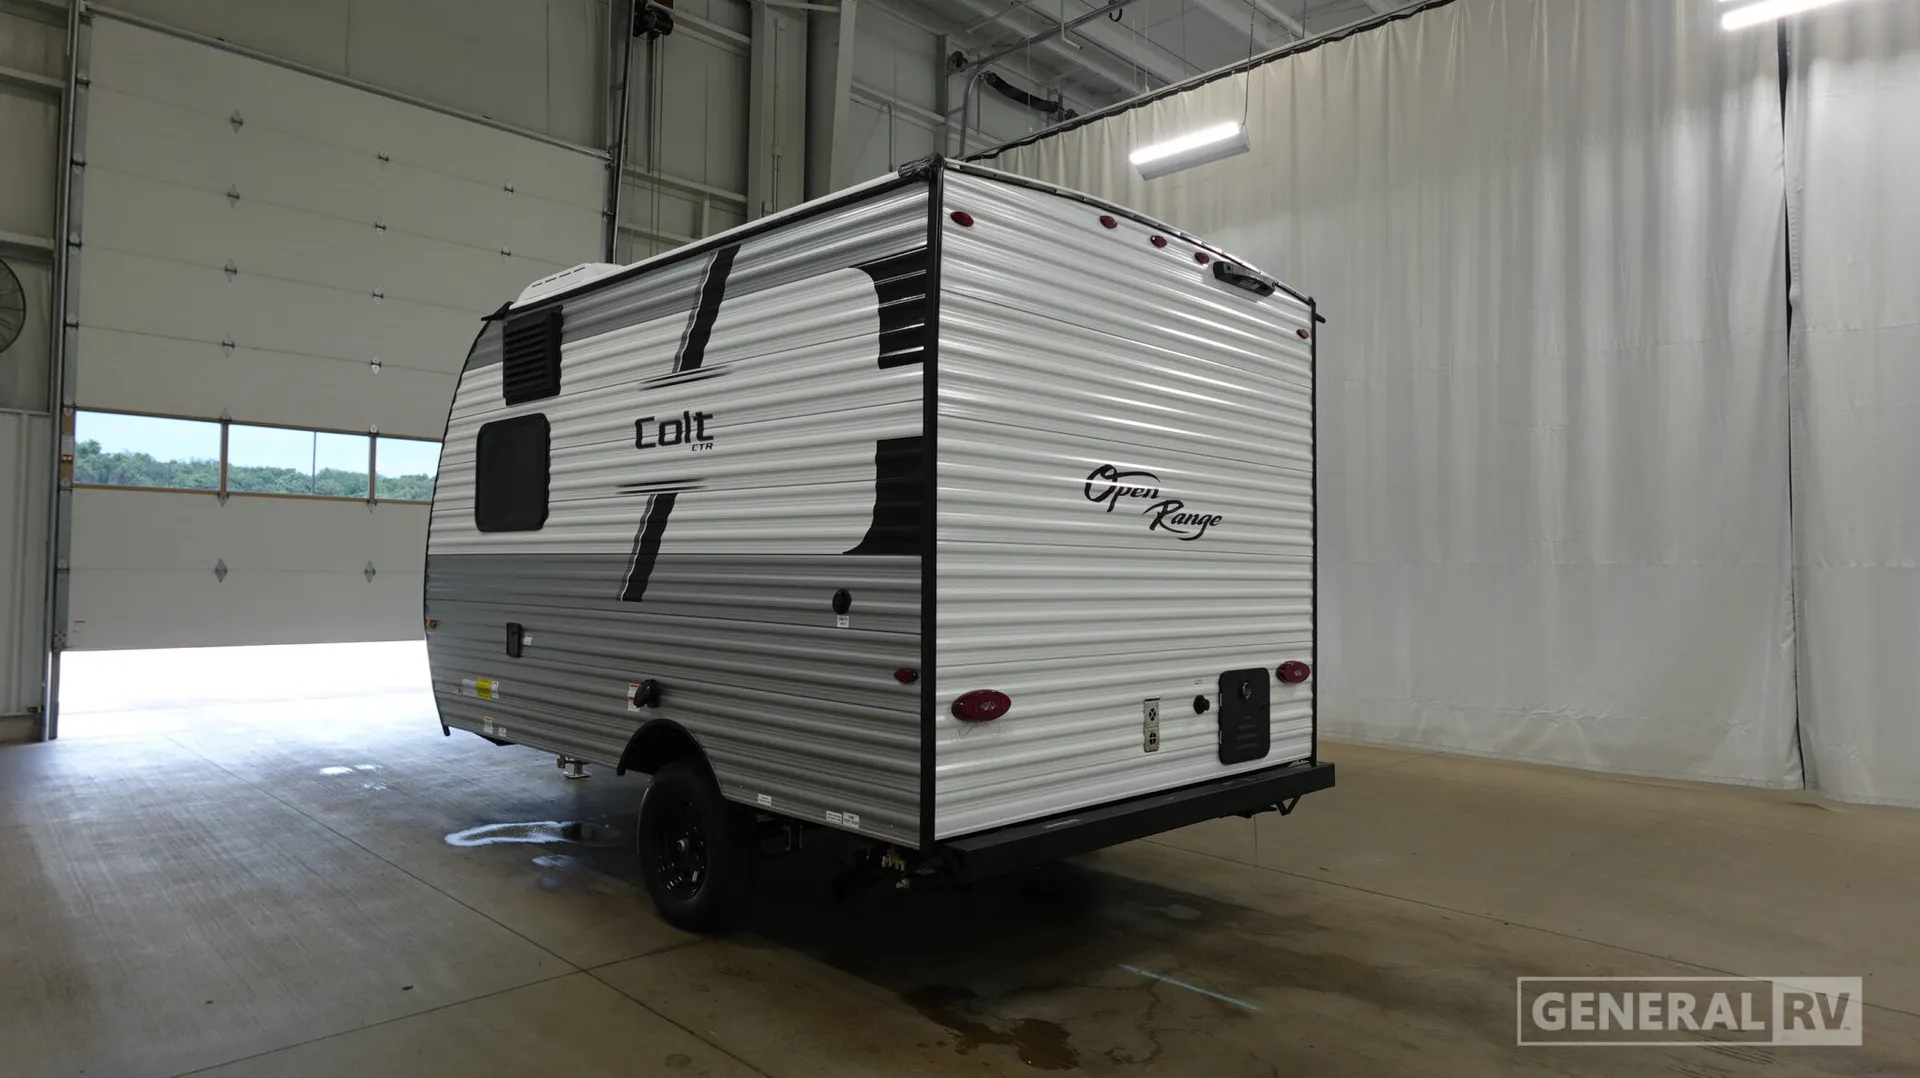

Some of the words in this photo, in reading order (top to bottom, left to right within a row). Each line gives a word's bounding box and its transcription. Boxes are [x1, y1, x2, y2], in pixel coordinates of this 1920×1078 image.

[635, 411, 714, 449] Colt
[691, 443, 713, 451] CTR
[1084, 464, 1161, 512] Open
[1142, 500, 1223, 541] Range
